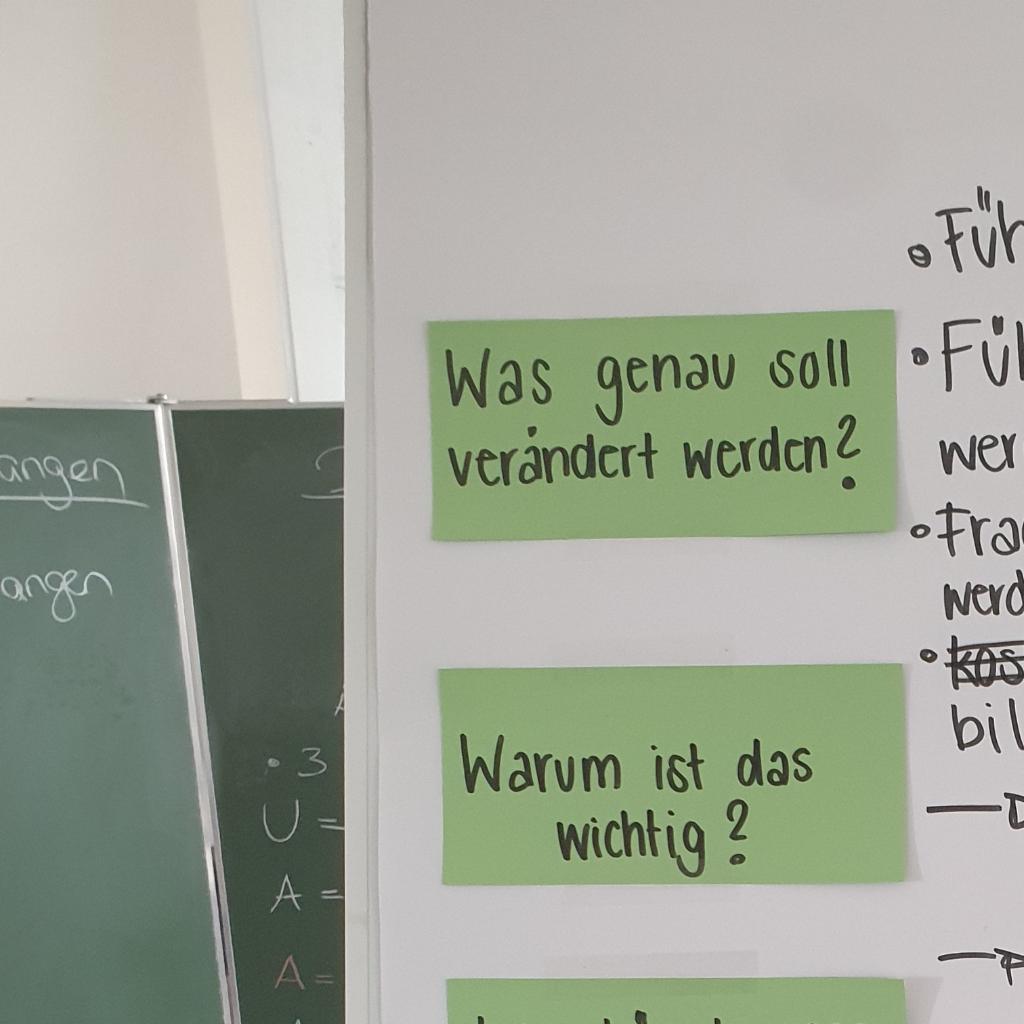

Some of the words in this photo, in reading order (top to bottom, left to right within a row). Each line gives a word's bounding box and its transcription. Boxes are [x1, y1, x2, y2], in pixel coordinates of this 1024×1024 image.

[446, 347, 553, 409] Was
[595, 353, 735, 427] genau
[769, 338, 850, 389] soll
[448, 426, 658, 487] verändert
[460, 733, 621, 795] Warum
[651, 743, 704, 793] ist
[736, 739, 813, 788] das
[270, 873, 301, 913] A
[274, 954, 305, 990] A
